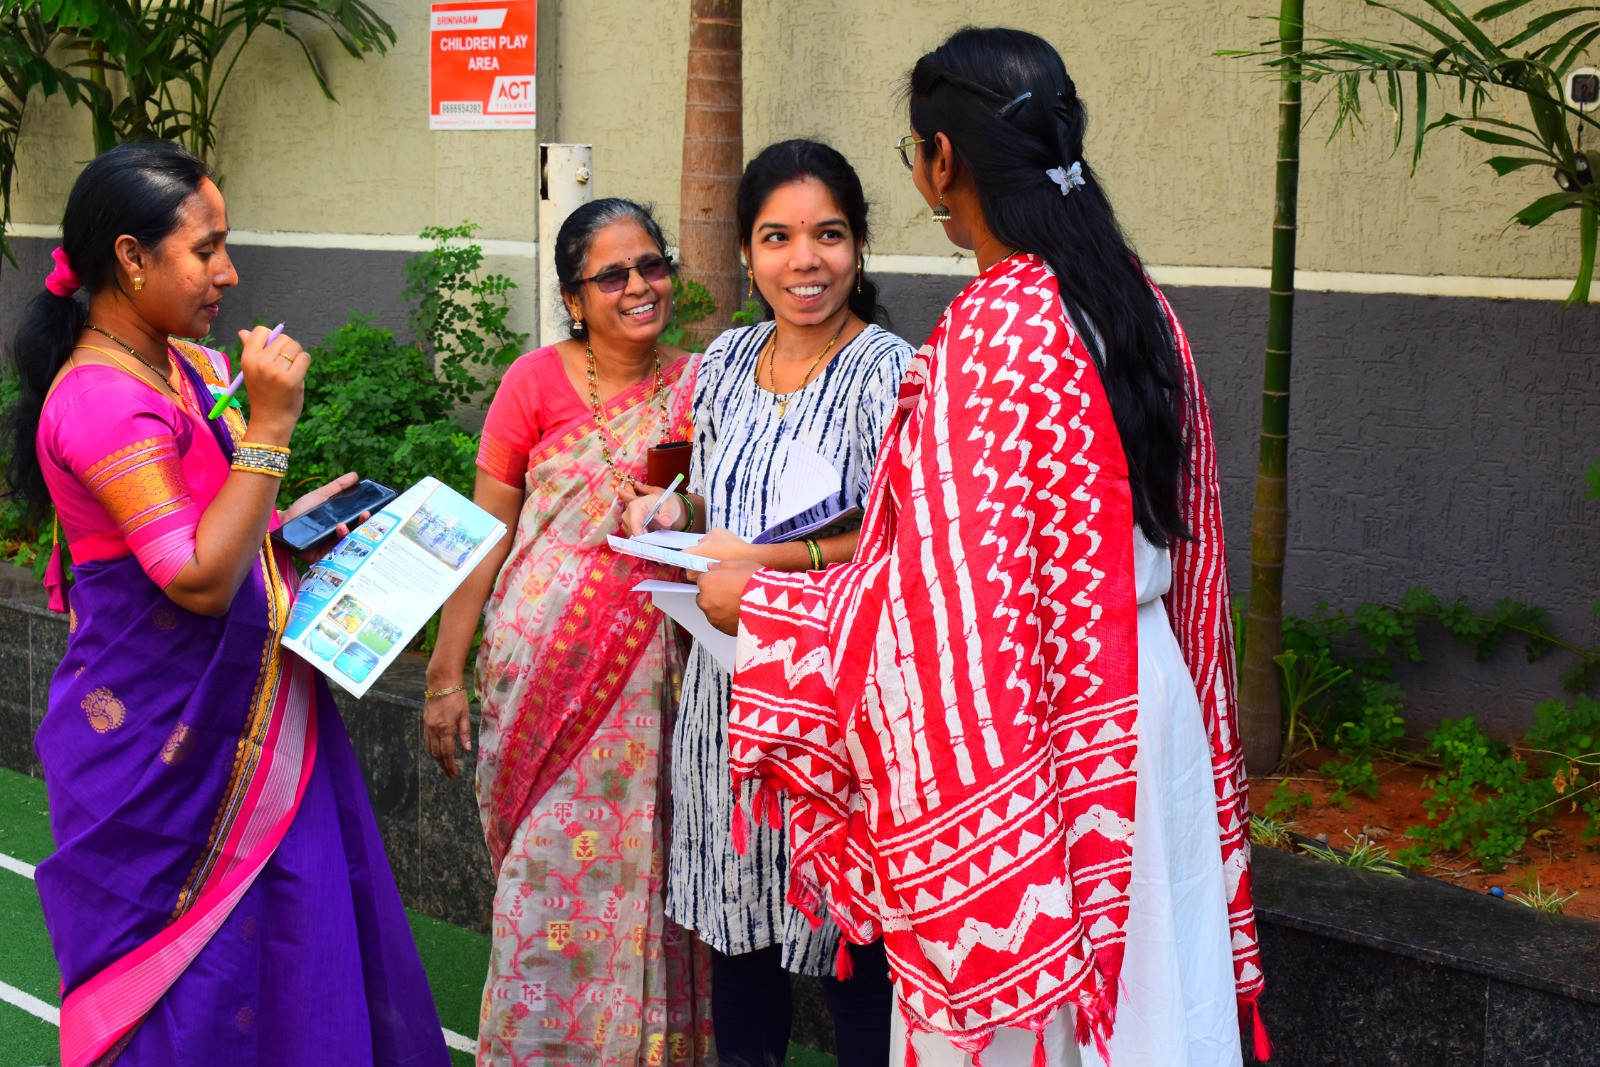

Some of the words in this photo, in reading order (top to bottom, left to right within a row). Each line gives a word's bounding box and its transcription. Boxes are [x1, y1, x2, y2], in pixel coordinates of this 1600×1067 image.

[437, 15, 478, 26] SRINIVASAM
[440, 36, 496, 51] CHILDREN
[499, 34, 528, 49] PLAY
[468, 56, 500, 71] AREA
[497, 81, 531, 100] ACT
